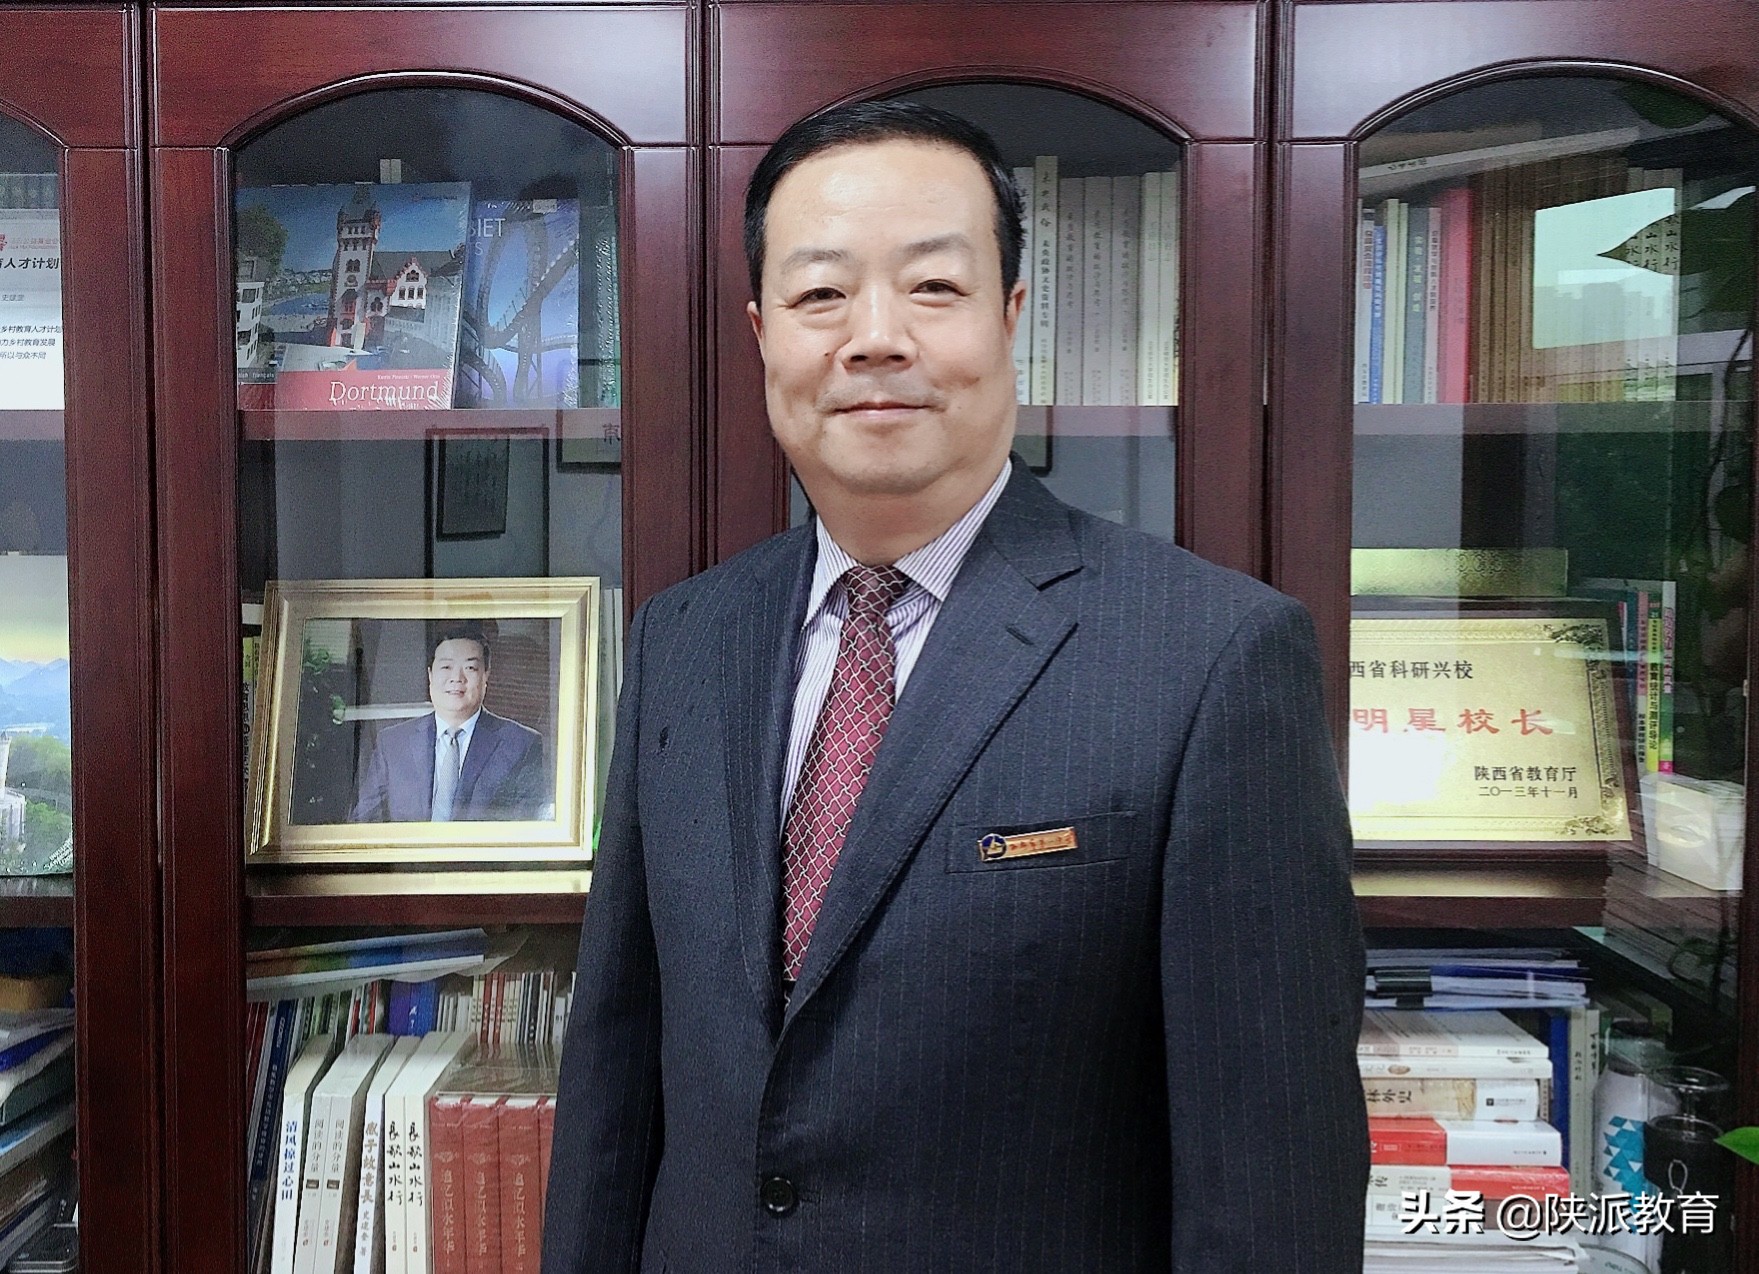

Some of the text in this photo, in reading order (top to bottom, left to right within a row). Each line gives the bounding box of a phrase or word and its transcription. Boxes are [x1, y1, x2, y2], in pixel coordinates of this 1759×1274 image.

[470, 218, 506, 238] IET
[0, 338, 56, 347] 力乡村教育发展
[328, 380, 440, 402] Dortmund
[1349, 659, 1474, 680] 西省科研兴校
[1352, 707, 1554, 736] 明星校长
[1474, 765, 1577, 782] 陕西省教育厅
